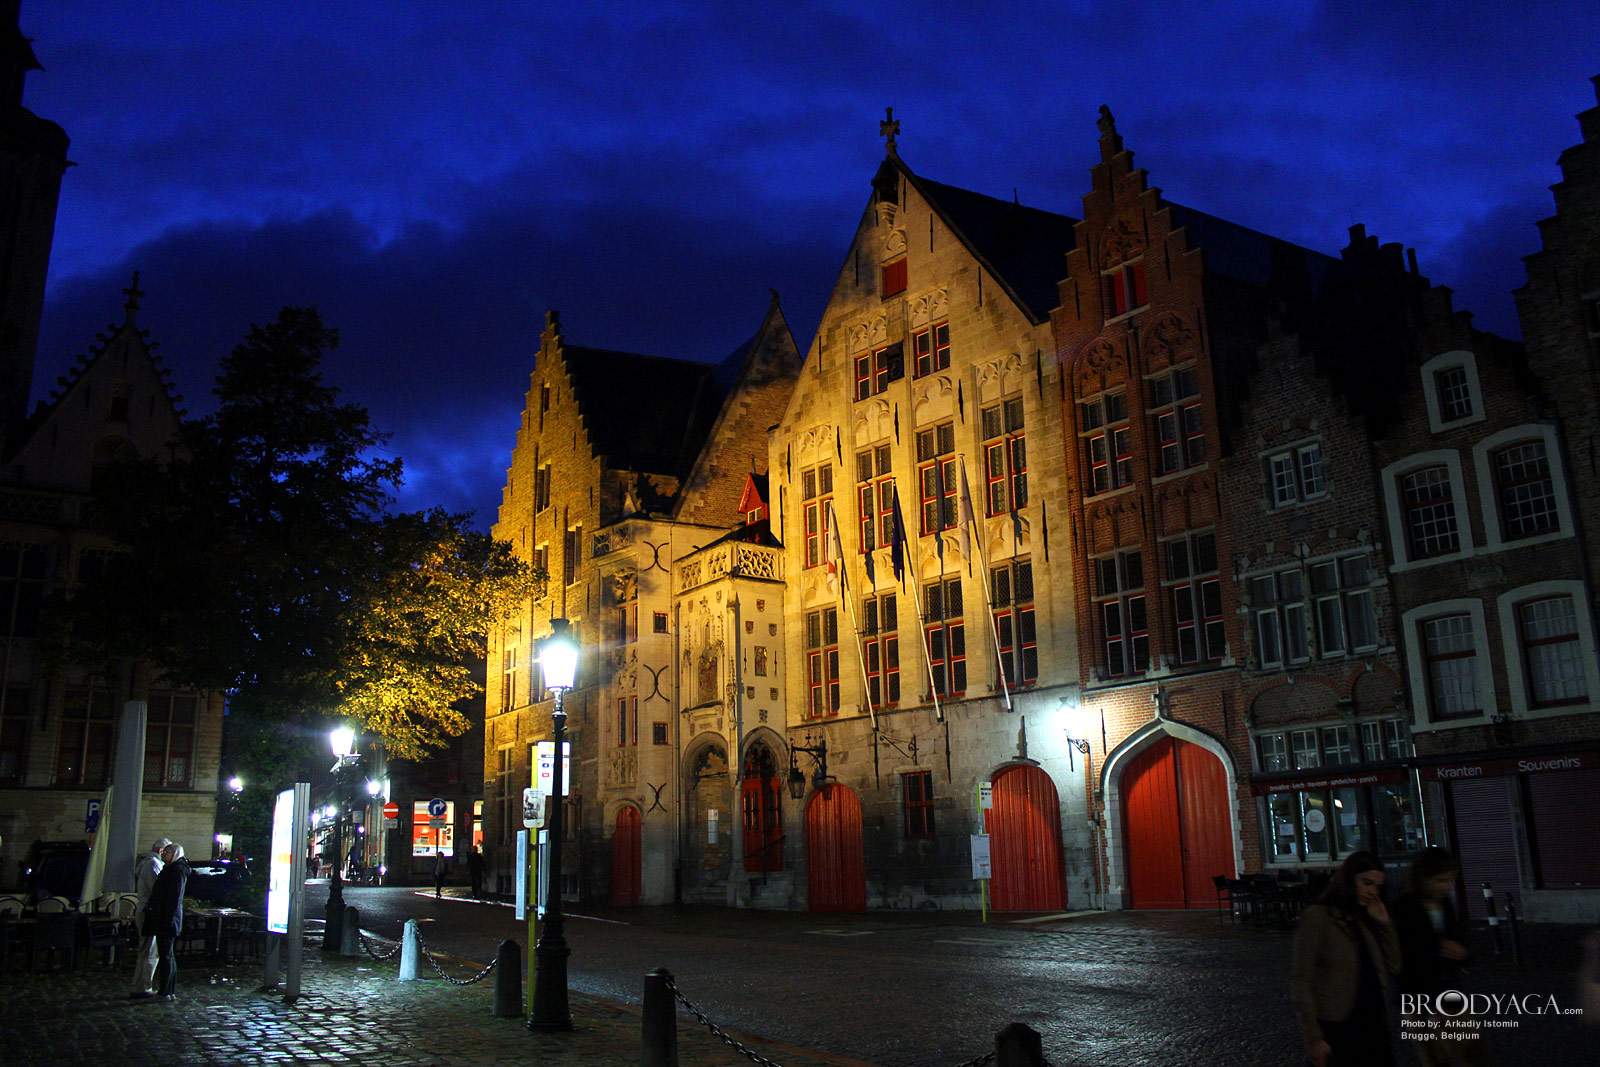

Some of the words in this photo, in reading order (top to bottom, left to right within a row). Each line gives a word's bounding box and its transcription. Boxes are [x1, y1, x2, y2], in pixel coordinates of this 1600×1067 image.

[1437, 765, 1483, 779] Kranten
[1518, 757, 1581, 772] Souvenirs
[88, 802, 100, 817] P
